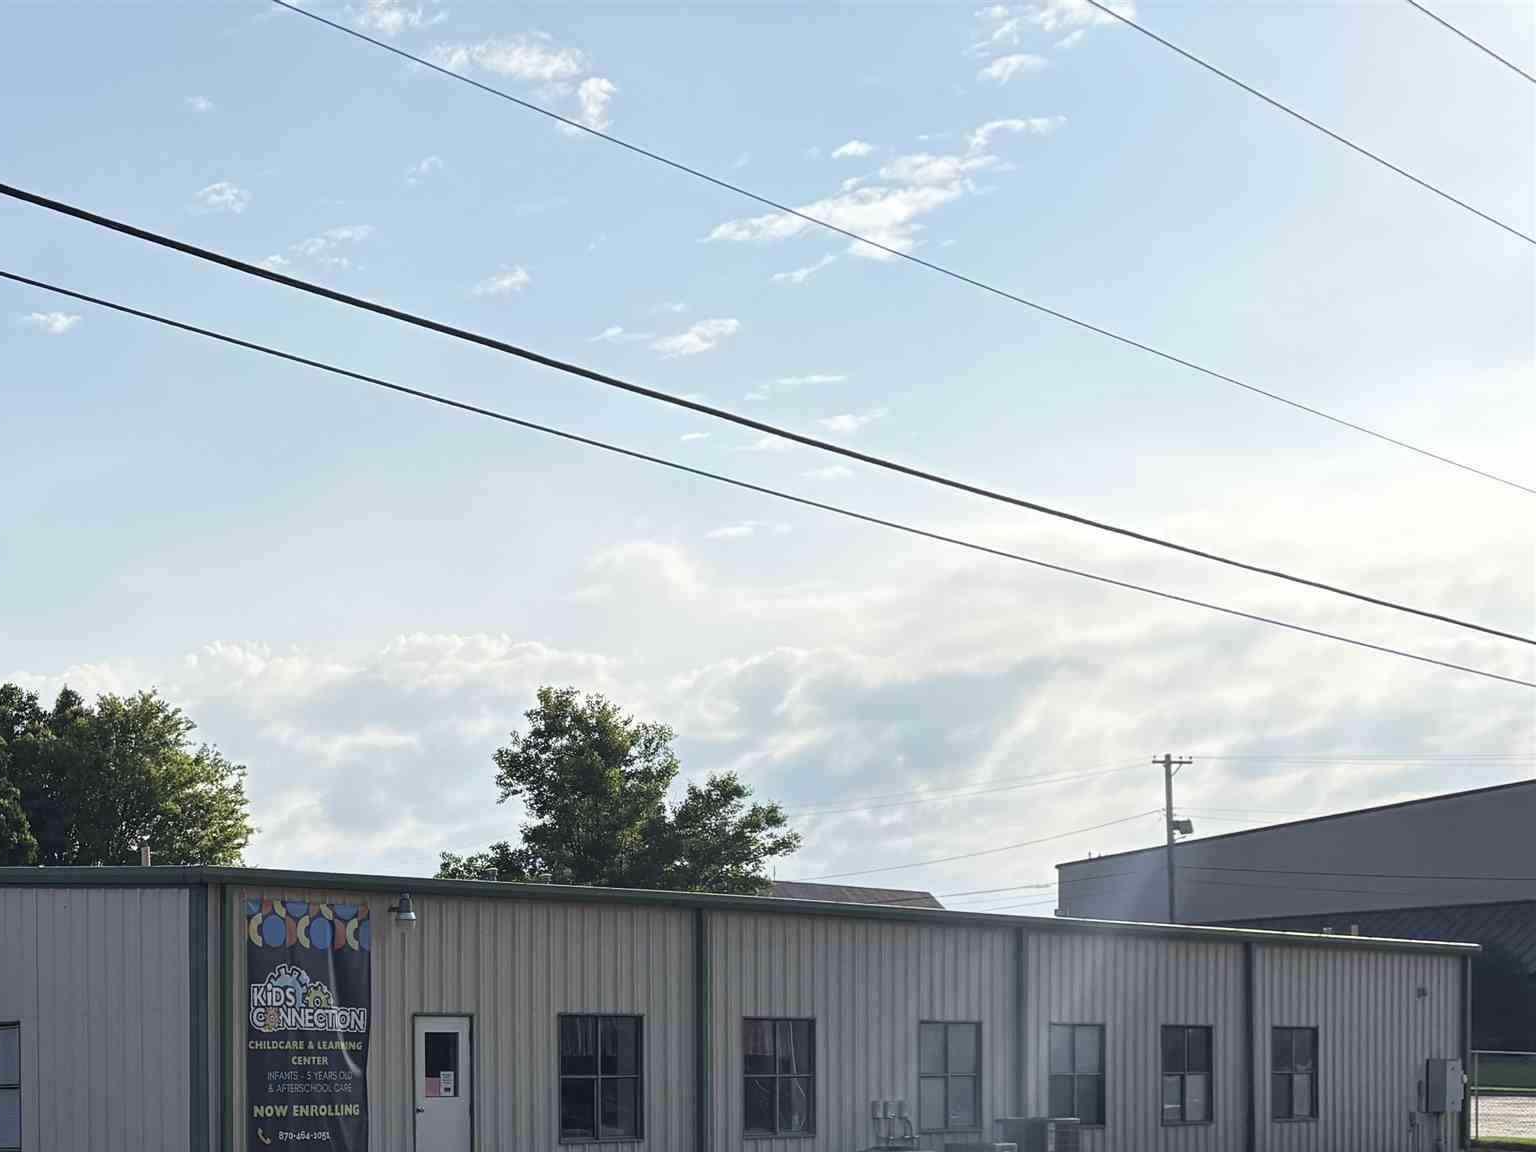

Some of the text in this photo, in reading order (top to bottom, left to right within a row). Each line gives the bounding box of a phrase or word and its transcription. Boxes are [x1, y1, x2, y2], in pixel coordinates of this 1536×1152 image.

[248, 1040, 305, 1050] CHILDCARE
[317, 1040, 363, 1050] LEARNING
[291, 1056, 329, 1065] CENTER
[267, 1071, 298, 1081] INFANTS
[313, 1071, 338, 1081] YEARS
[339, 1071, 353, 1081] OLD
[276, 1083, 332, 1093] AFTERSCHOOL
[334, 1083, 353, 1093] CARE
[253, 1104, 360, 1117] NOW ENROLLING
